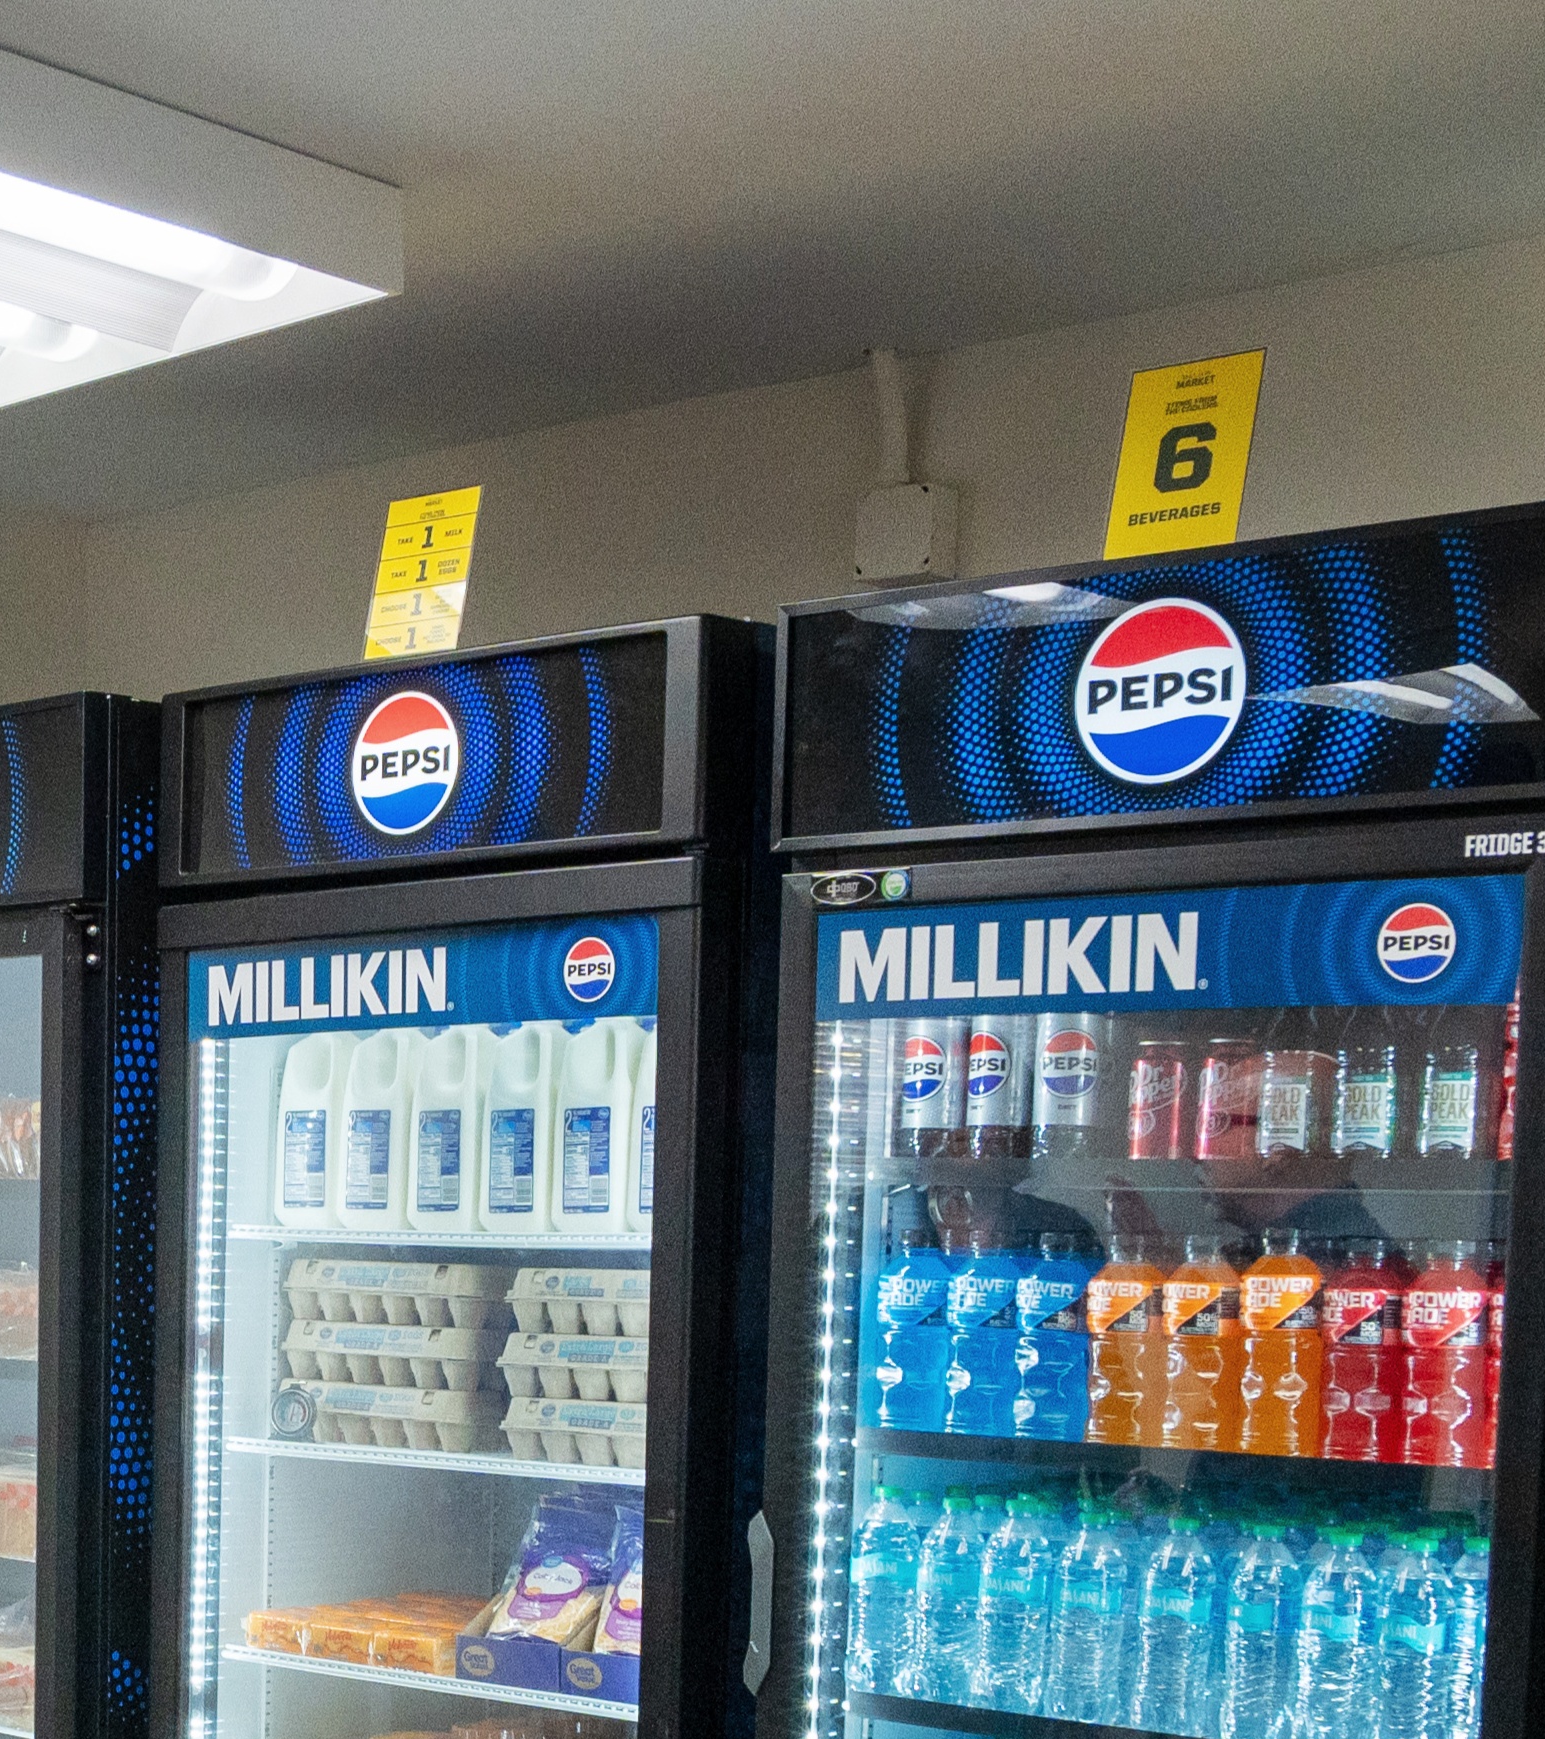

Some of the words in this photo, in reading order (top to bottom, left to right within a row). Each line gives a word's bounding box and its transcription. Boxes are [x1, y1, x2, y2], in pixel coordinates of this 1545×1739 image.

[1176, 374, 1216, 389] MARKET
[1154, 421, 1217, 493] 6
[1128, 502, 1221, 527] BEVERAGES
[397, 536, 414, 545] TAKE
[421, 525, 434, 549] 1
[444, 528, 463, 537] MILK
[391, 570, 407, 579] TAKE
[415, 559, 428, 583] 1
[437, 559, 460, 568] DOZEN
[410, 593, 422, 616] 1
[405, 627, 416, 649] 1
[1086, 664, 1235, 716] PEPSI
[359, 743, 451, 782] PEPSI
[1464, 832, 1532, 859] FRIDGE
[1383, 933, 1452, 954] PEPSI
[837, 911, 1200, 1004] MILLIKIN
[567, 961, 612, 978] PEPSI
[208, 946, 447, 1027] MILLIKIN
[905, 1062, 944, 1076] EPSI
[970, 1058, 1006, 1072] EPSI
[1043, 1056, 1097, 1072] PEPSI
[1431, 1084, 1470, 1101] GOLD
[1430, 1104, 1468, 1120] PEAK
[1163, 1282, 1210, 1299] OWER
[1249, 1277, 1313, 1293] POWER
[1247, 1293, 1281, 1308] ADE
[1324, 1292, 1375, 1308] OWER
[1409, 1291, 1482, 1308] POWER
[1411, 1308, 1449, 1324] ADE
[464, 1651, 488, 1663] Great
[569, 1664, 595, 1676] Great
